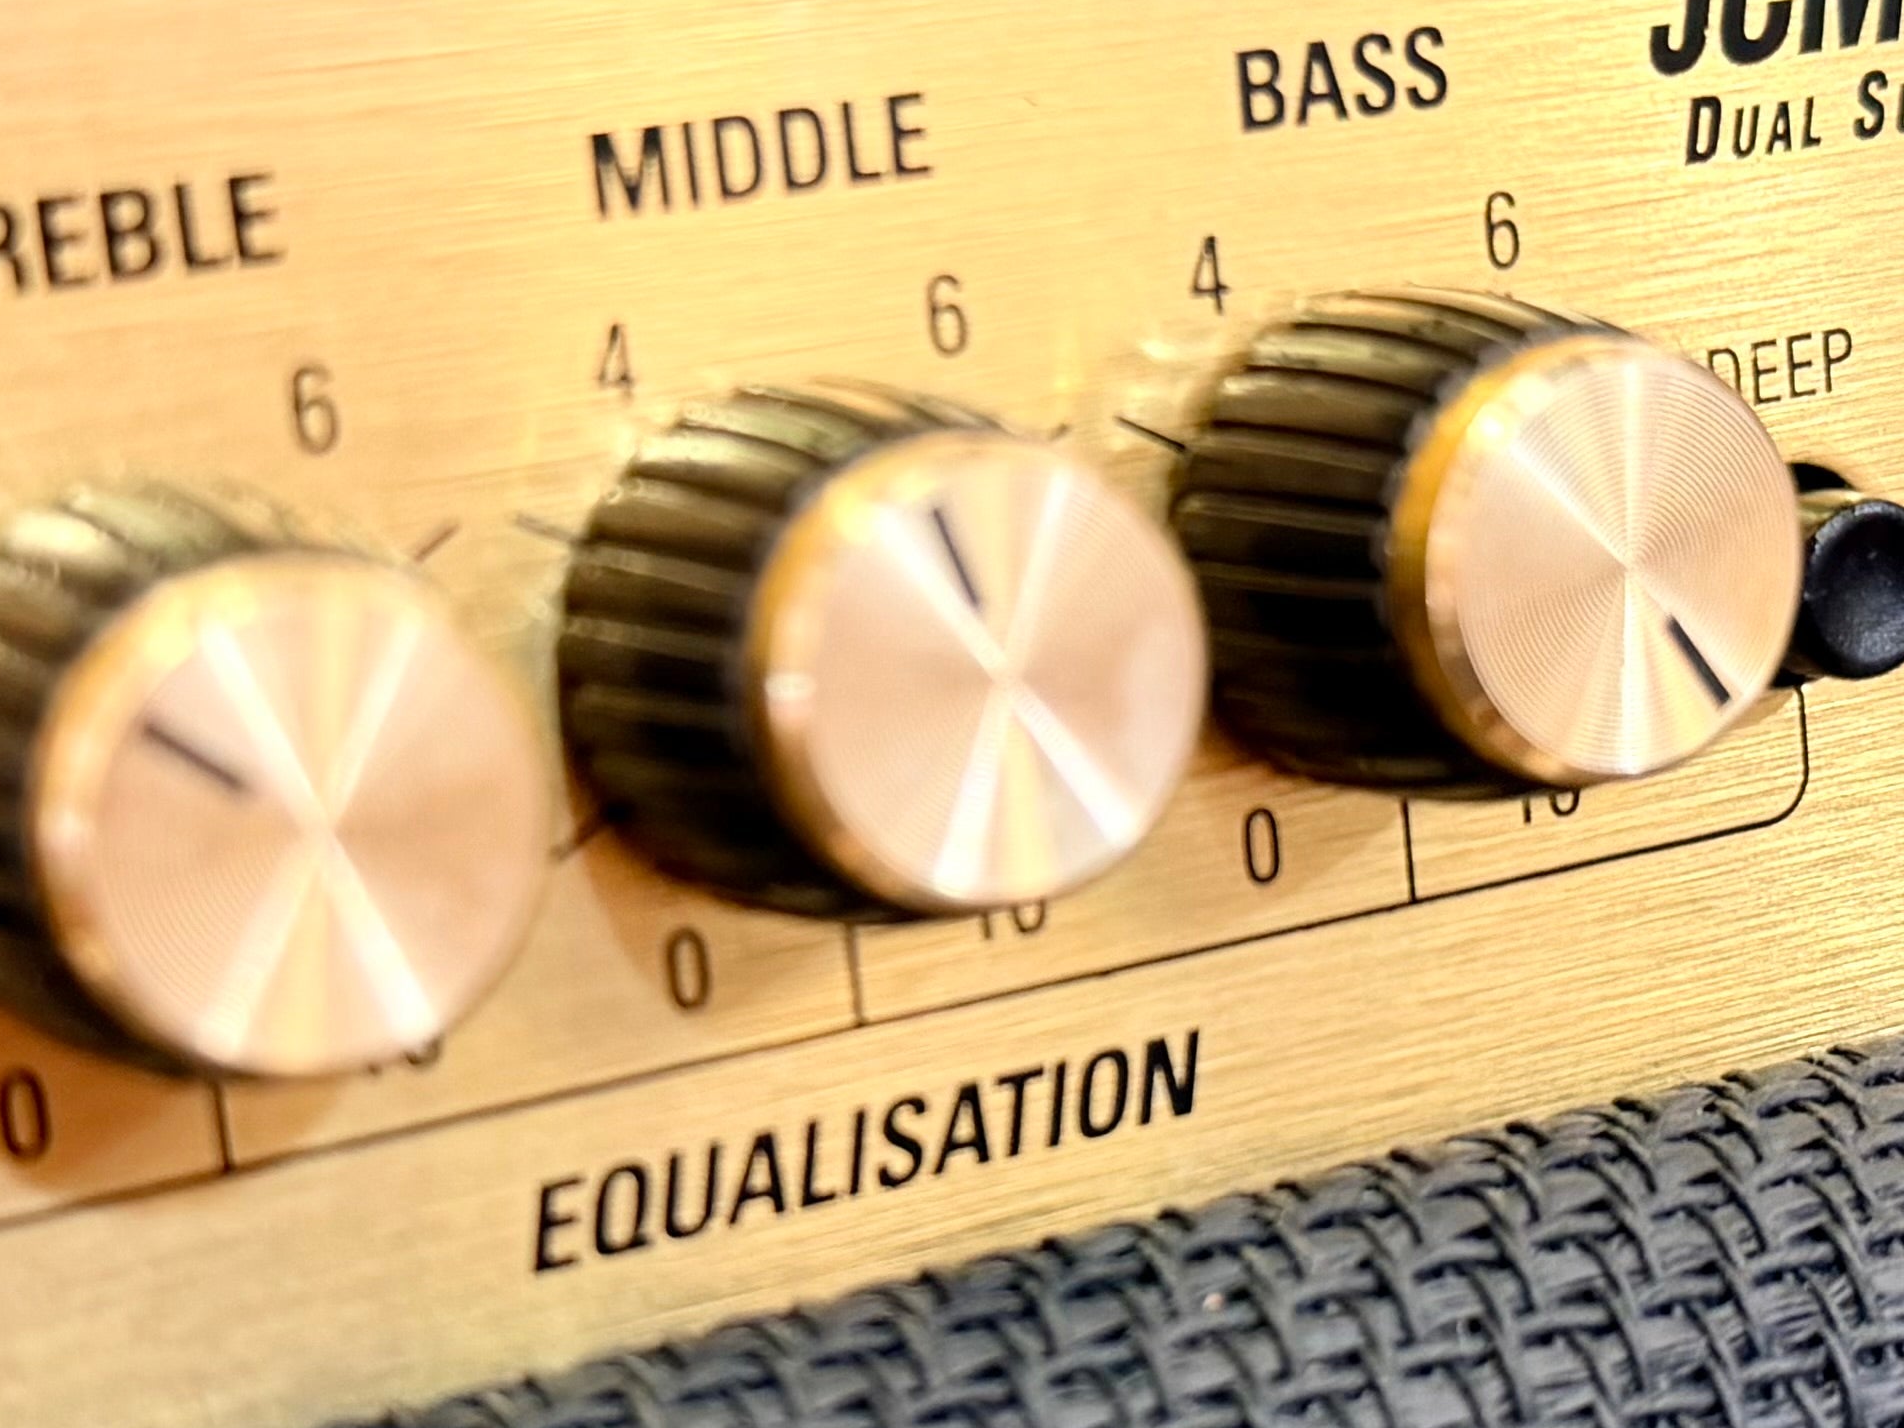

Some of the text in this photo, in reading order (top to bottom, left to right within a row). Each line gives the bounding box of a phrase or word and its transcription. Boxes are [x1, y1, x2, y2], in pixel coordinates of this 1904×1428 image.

[1234, 26, 1450, 135] BASS
[589, 92, 934, 220] MIDDLE
[1685, 93, 1822, 166] DUAL
[1486, 191, 1521, 270] 6
[927, 274, 970, 358] 6
[1191, 235, 1230, 315] 4
[598, 322, 635, 398] 4
[1706, 327, 1853, 407] DEEP
[289, 361, 341, 454] 6
[1244, 808, 1280, 884] 0
[664, 928, 711, 1013] 0
[531, 1027, 1202, 1273] EQUALISATION
